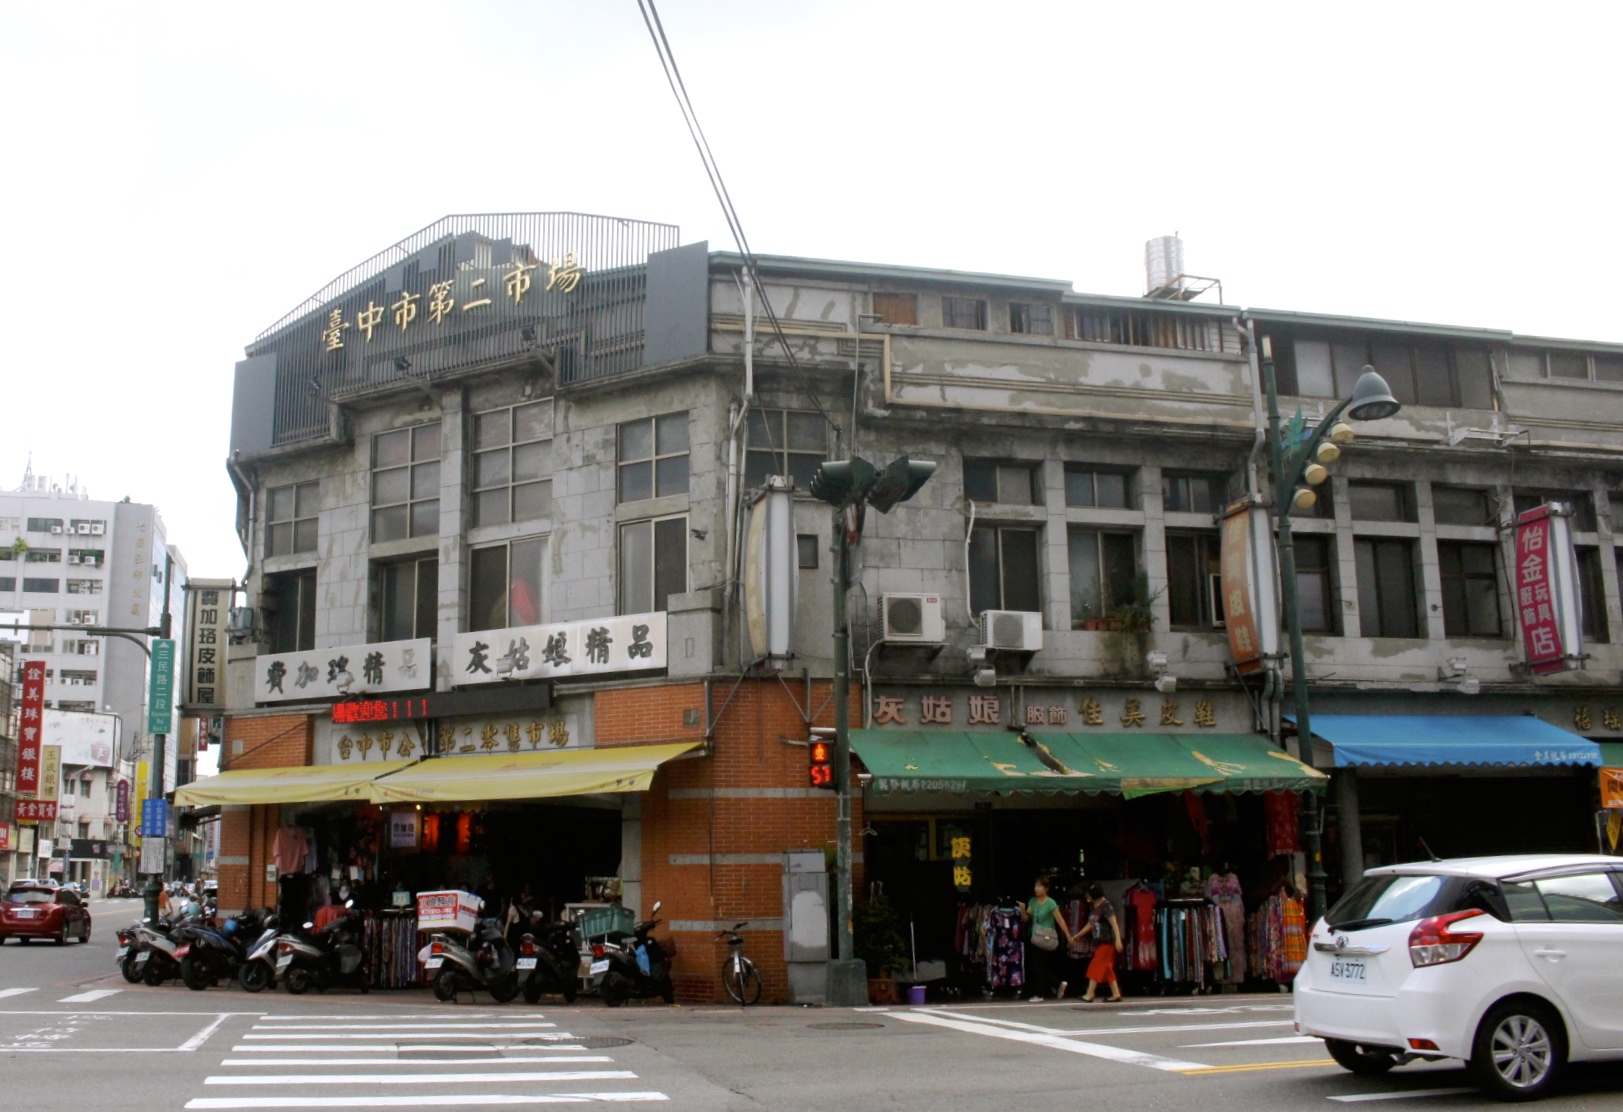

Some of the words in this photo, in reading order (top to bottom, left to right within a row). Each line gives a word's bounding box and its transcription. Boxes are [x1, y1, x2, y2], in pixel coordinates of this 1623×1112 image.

[322, 250, 587, 353] 臺中市第二市場
[1521, 525, 1544, 584] 怡金
[465, 624, 654, 674] 灰姑娘精品
[1531, 627, 1556, 656] 店
[155, 651, 170, 710] 三民路二段
[873, 695, 1002, 725] 灰姑娘
[1026, 705, 1068, 725] 服飾
[1077, 696, 1218, 728] 佳美皮鞋
[337, 721, 569, 761] 台中市公第二零售市場
[44, 750, 57, 798] 玉成銀樓
[810, 765, 832, 785] 57
[17, 802, 56, 819] 黃金買賣
